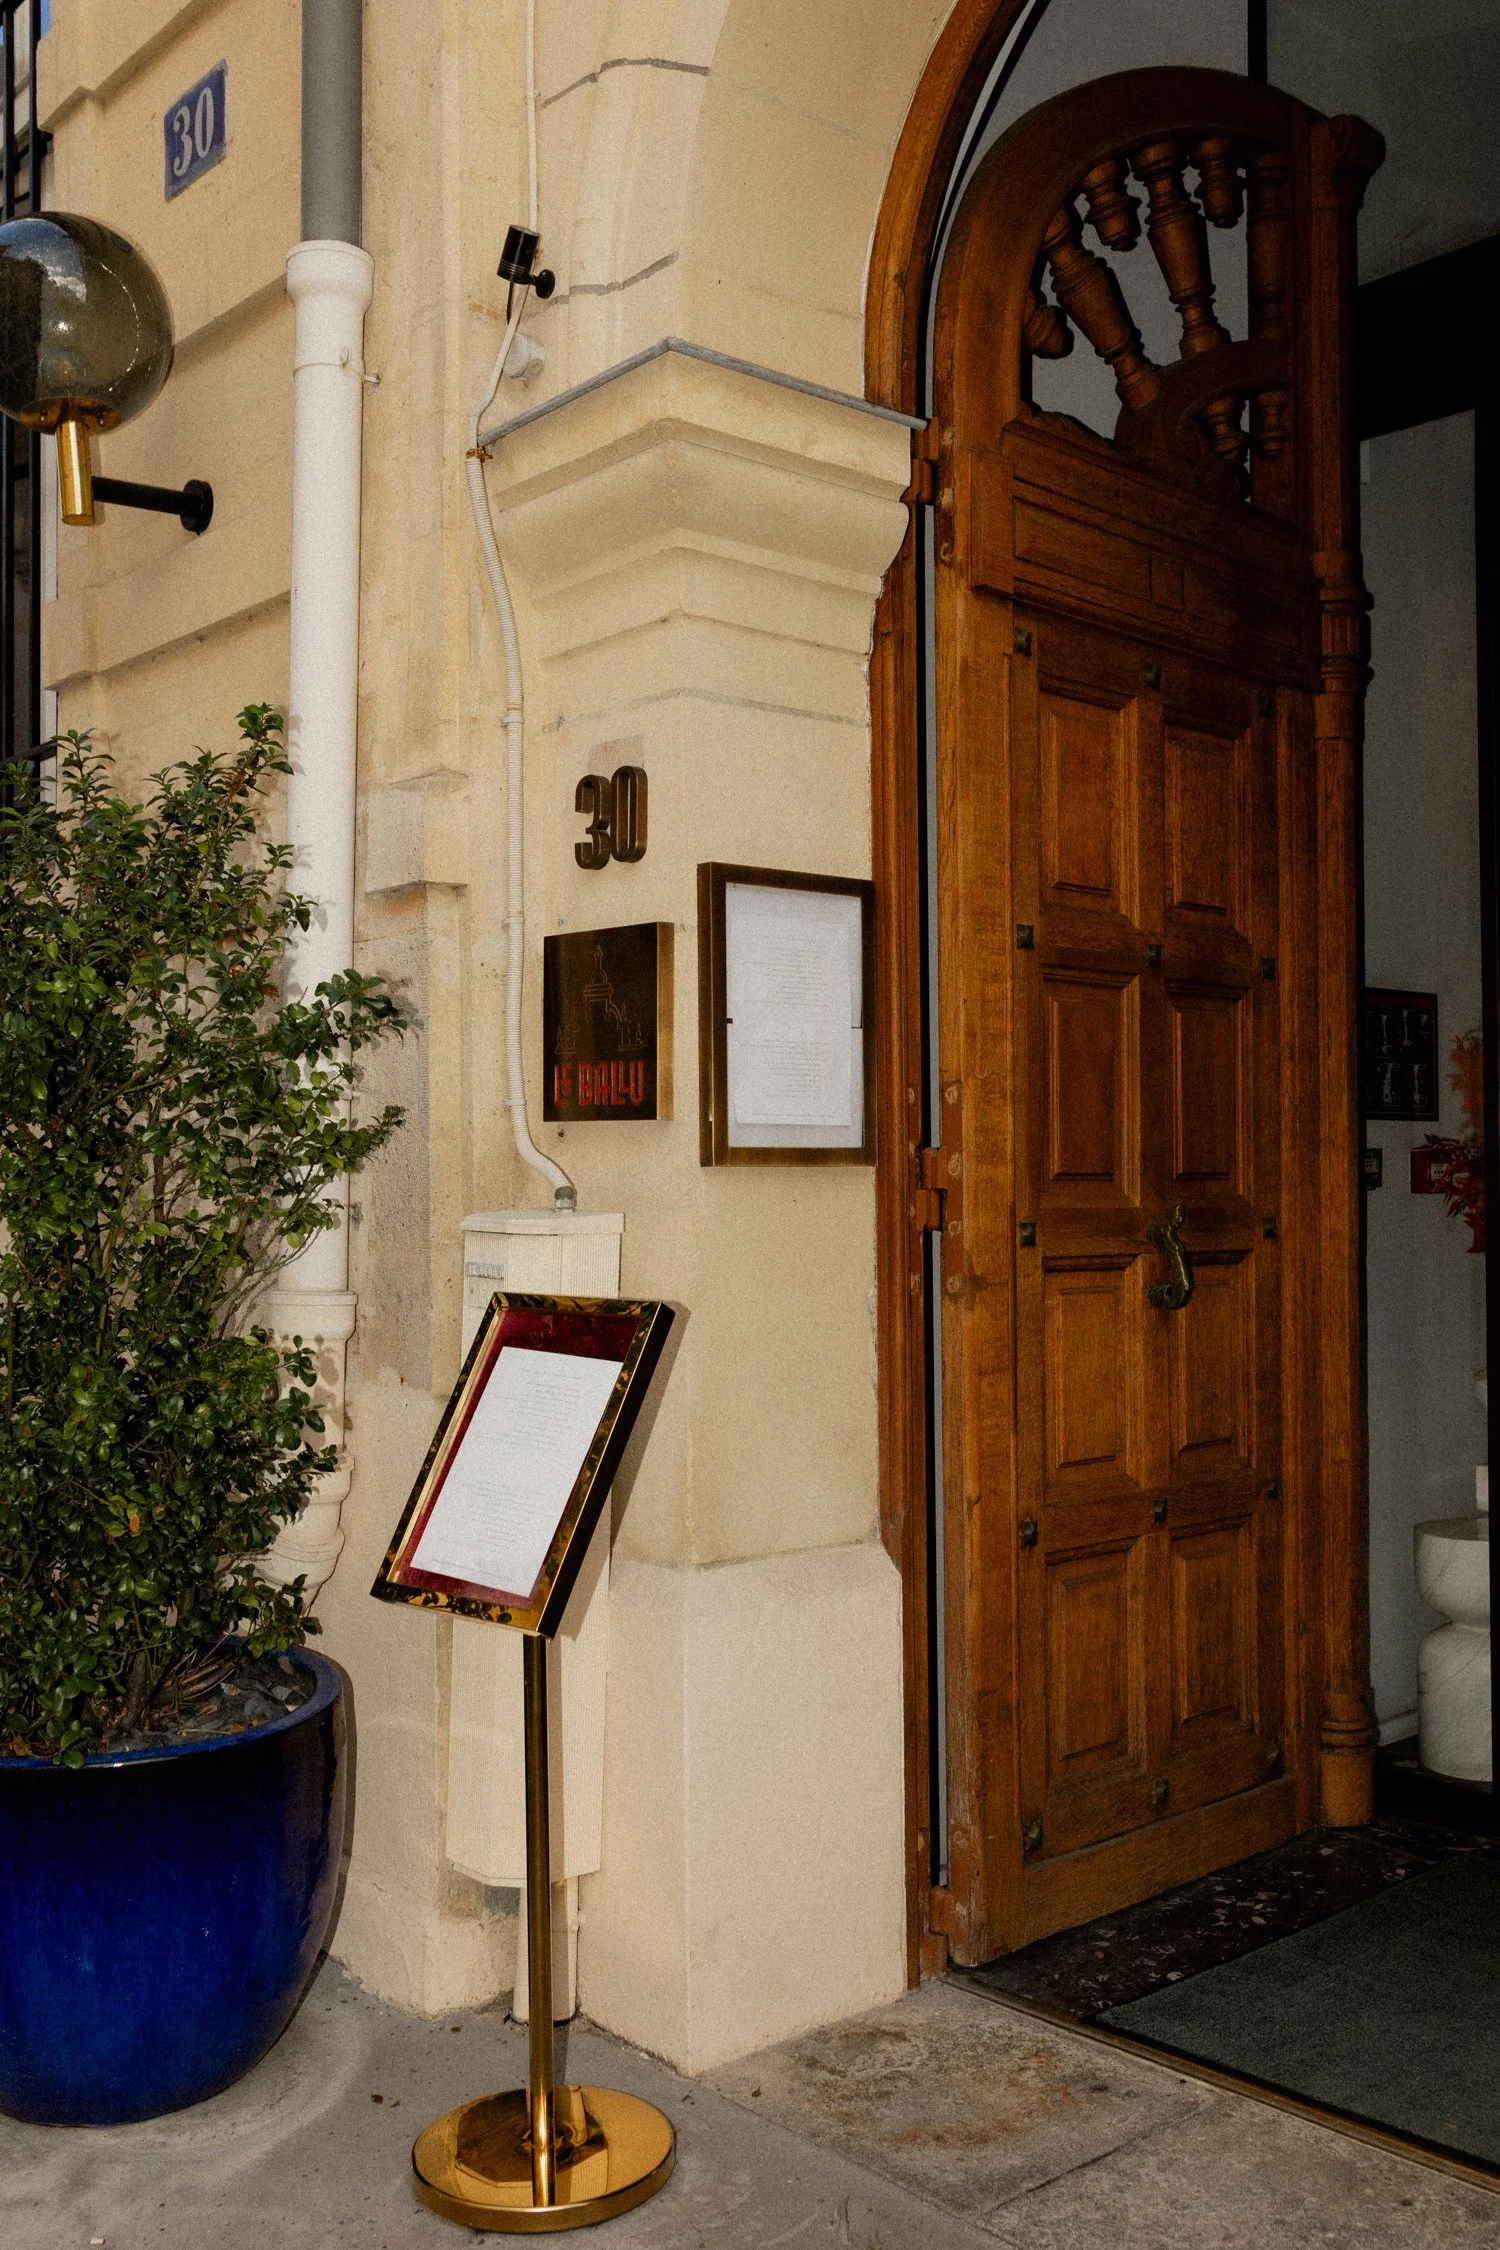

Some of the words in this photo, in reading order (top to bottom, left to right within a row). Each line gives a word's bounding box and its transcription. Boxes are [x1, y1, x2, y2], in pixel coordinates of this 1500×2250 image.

[173, 87, 214, 177] 30
[575, 765, 648, 870] 30
[554, 1063, 573, 1106] LE
[579, 1060, 644, 1106] BALLU
